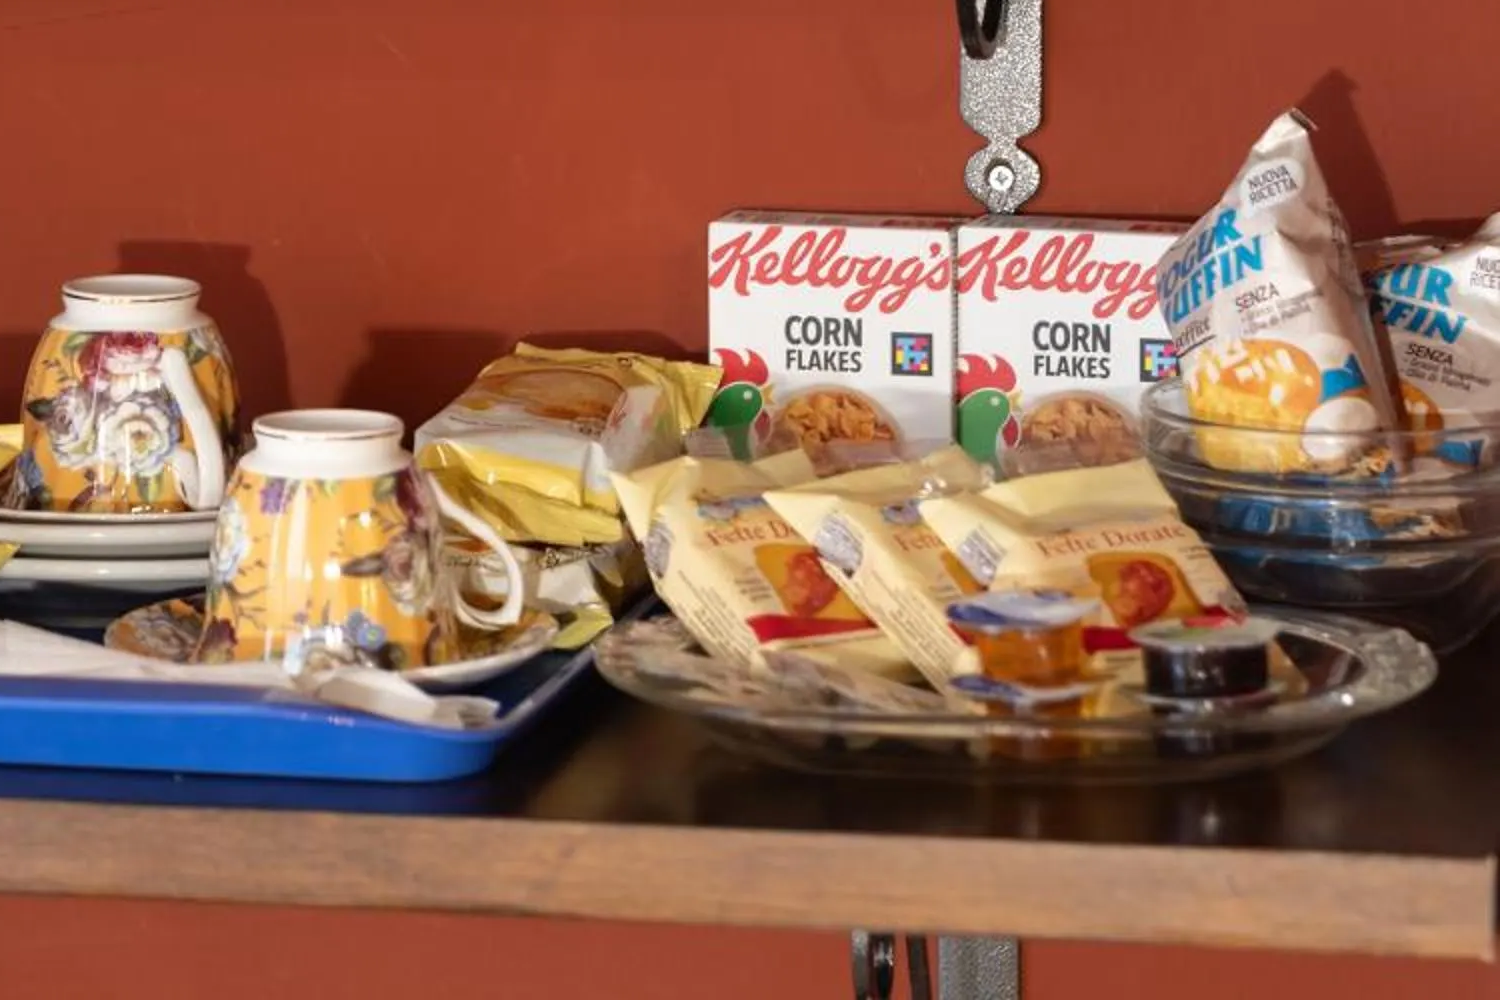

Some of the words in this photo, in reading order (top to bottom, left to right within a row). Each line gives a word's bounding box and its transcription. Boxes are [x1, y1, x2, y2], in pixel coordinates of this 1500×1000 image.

[1247, 164, 1291, 190] NUOVA
[1248, 178, 1298, 204] RICETTA
[709, 226, 951, 314] Kellogg's
[1235, 281, 1280, 311] SENZA
[785, 316, 863, 347] CORN
[1032, 320, 1111, 354] CORN
[785, 349, 862, 374] FLAKES
[1033, 354, 1111, 379] FLAKES
[1405, 343, 1454, 366] SENZA
[1101, 522, 1186, 550] Dorate
